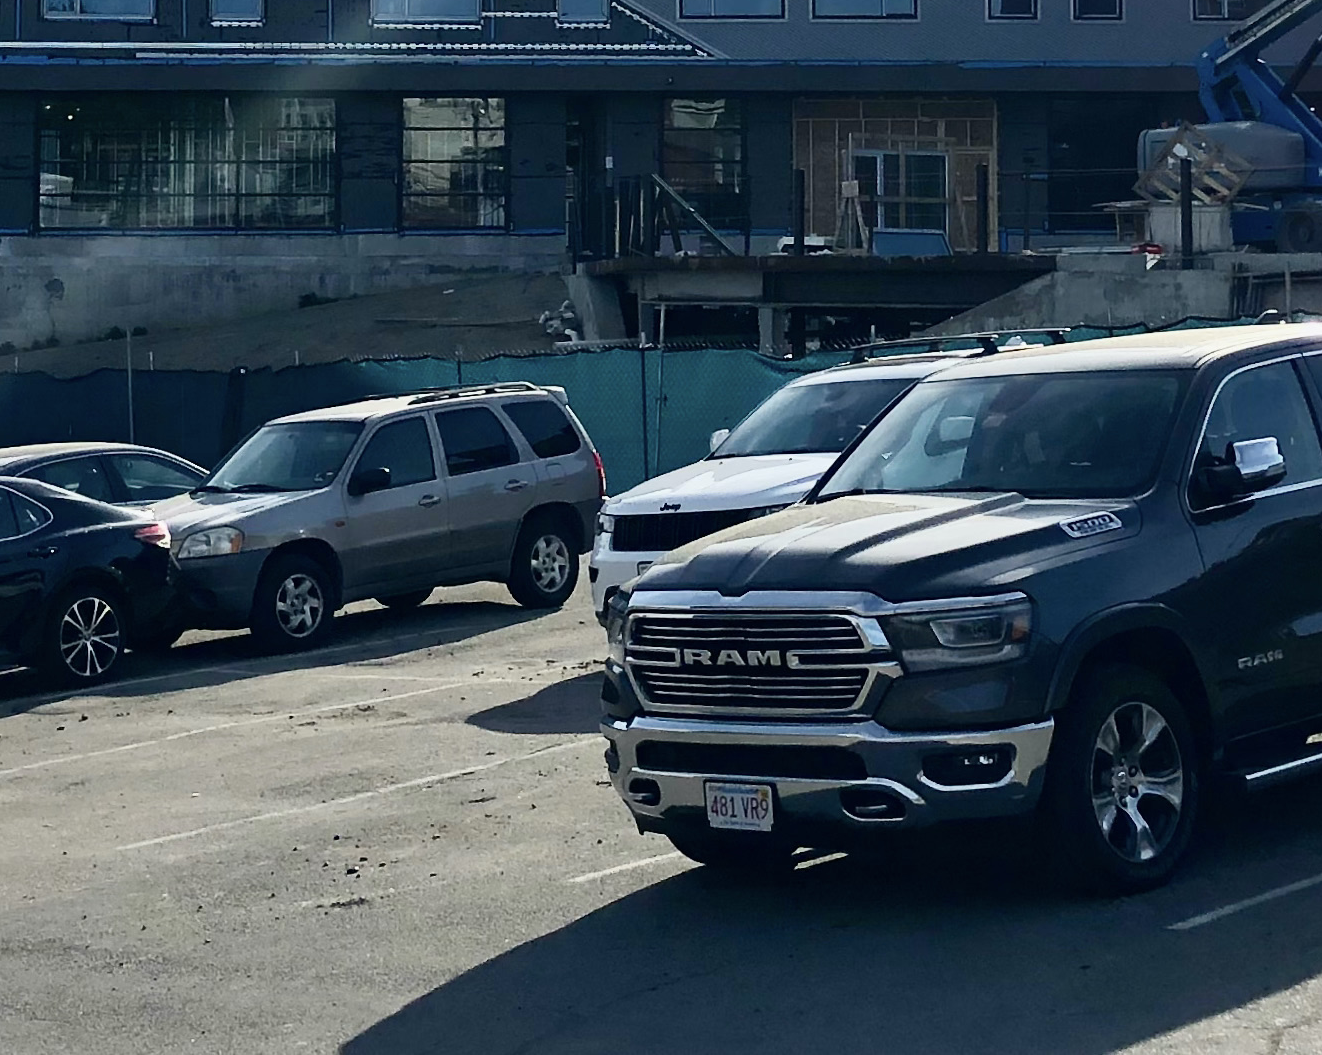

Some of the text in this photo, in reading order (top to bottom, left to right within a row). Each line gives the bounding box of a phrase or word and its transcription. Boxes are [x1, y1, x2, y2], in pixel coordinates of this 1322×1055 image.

[683, 648, 781, 666] RAM
[711, 795, 769, 821] 481 VR9
